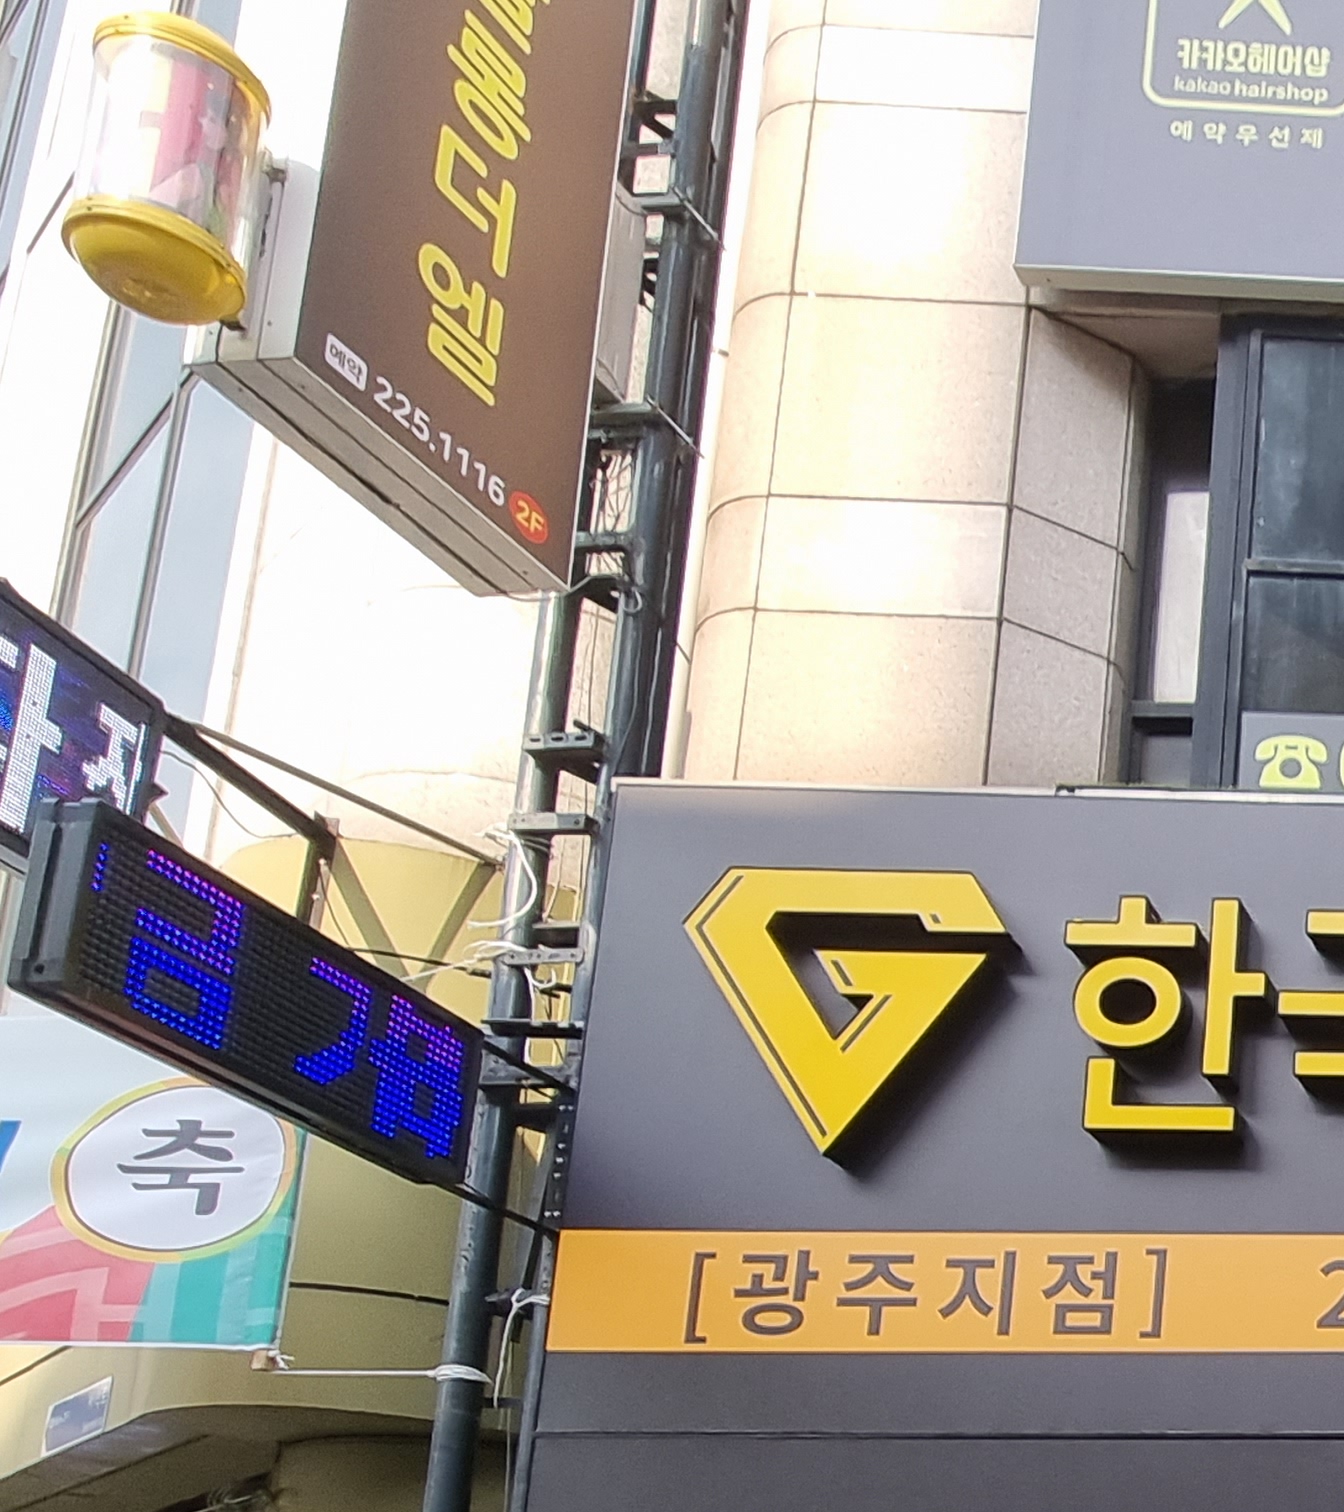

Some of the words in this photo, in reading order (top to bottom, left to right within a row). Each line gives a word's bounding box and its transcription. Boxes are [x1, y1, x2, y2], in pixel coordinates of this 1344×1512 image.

[1174, 74, 1231, 95] kakao
[1235, 78, 1329, 105] hairshop
[1177, 38, 1331, 77] 카카오헤어샵
[1170, 120, 1324, 149] 예약우선제
[418, 0, 550, 407] 롱더엘
[373, 376, 506, 507] 225.1116
[516, 500, 544, 533] 2F
[116, 1119, 245, 1216] 축
[686, 1247, 1169, 1345] [광주지점]
